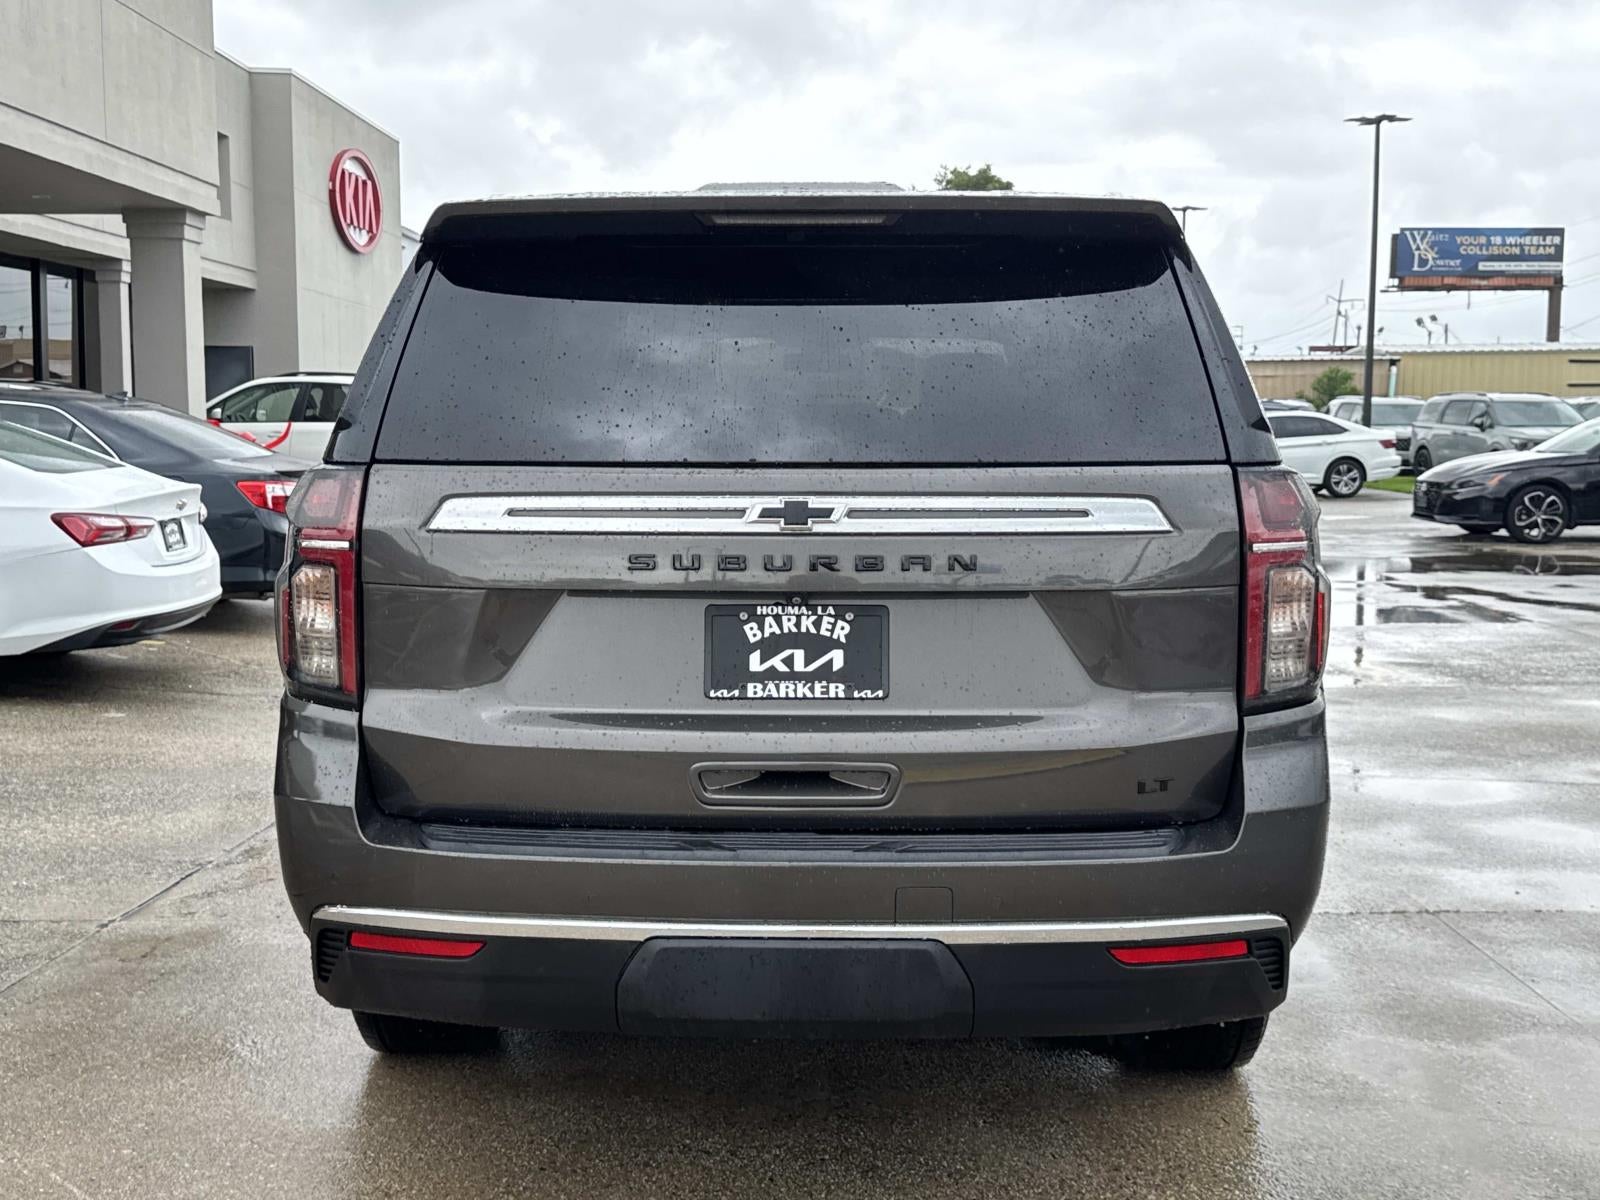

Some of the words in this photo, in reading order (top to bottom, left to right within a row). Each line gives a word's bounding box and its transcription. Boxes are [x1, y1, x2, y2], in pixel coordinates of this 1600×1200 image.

[342, 168, 377, 234] KIA
[1455, 235, 1487, 245] YOUR
[1490, 235, 1502, 245] 18
[1504, 235, 1561, 245] WHEELER
[1459, 245, 1520, 255] COLLISION
[1523, 246, 1555, 255] TEAM
[627, 553, 979, 572] SUBURBAN
[756, 605, 812, 616] HOUMA,
[816, 605, 836, 616] LA
[742, 615, 851, 644] BARKER
[748, 649, 845, 673] KIA
[746, 682, 846, 698] BARKER
[1137, 777, 1176, 794] LT
